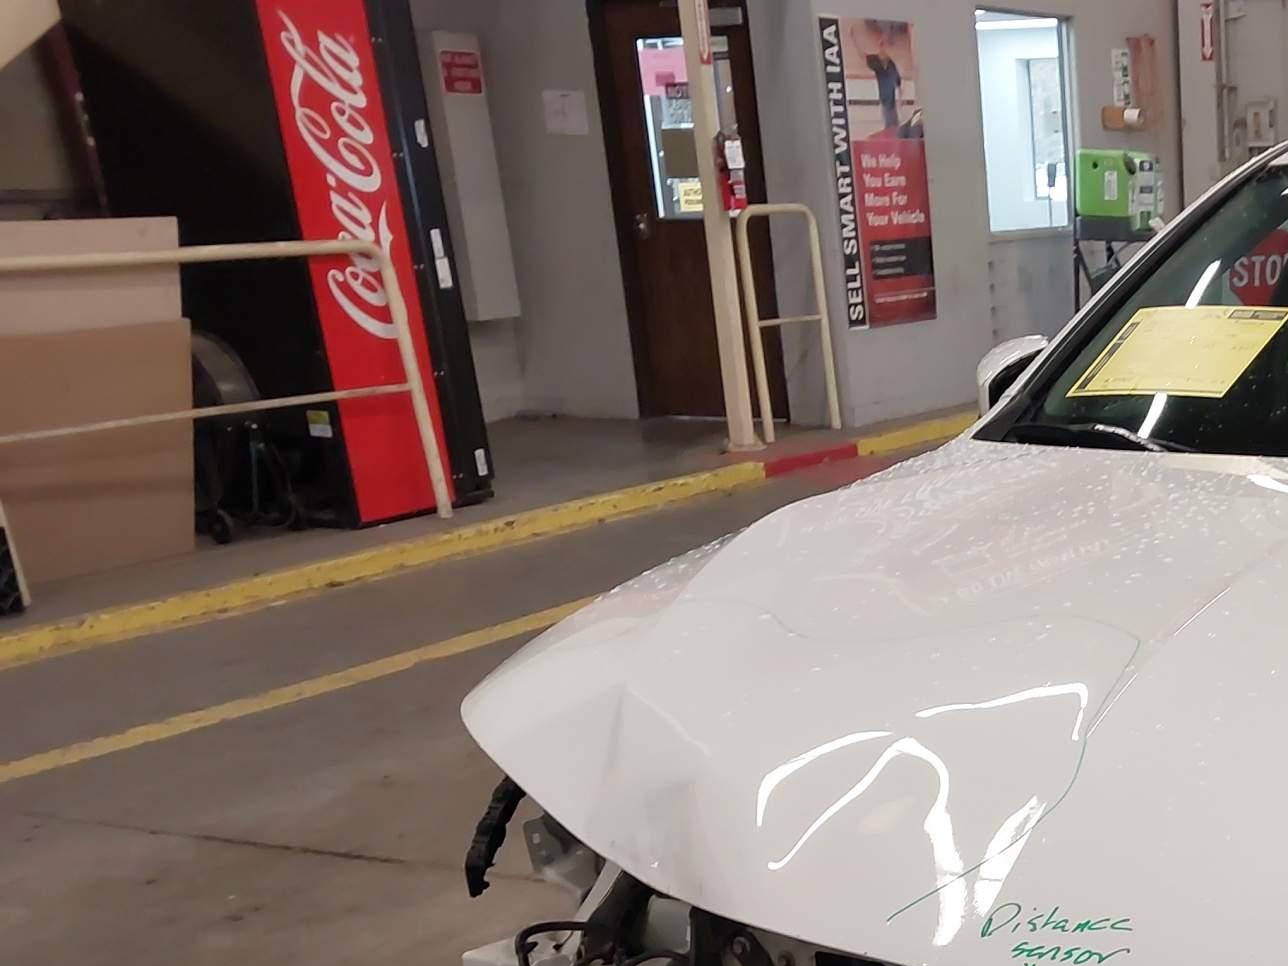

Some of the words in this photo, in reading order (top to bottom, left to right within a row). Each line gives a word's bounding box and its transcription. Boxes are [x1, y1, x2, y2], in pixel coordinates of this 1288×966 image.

[823, 24, 841, 73] IAA
[829, 82, 848, 154] WITH
[278, 10, 399, 339] Coca-Cola
[860, 153, 877, 168] We
[878, 153, 901, 170] Help
[863, 173, 882, 188] You
[884, 173, 907, 187] Earn
[835, 160, 857, 255] SMART
[864, 192, 890, 207] More
[892, 191, 908, 206] For
[866, 211, 889, 226] Your
[891, 209, 925, 225] Vehicle
[846, 261, 865, 321] SELL
